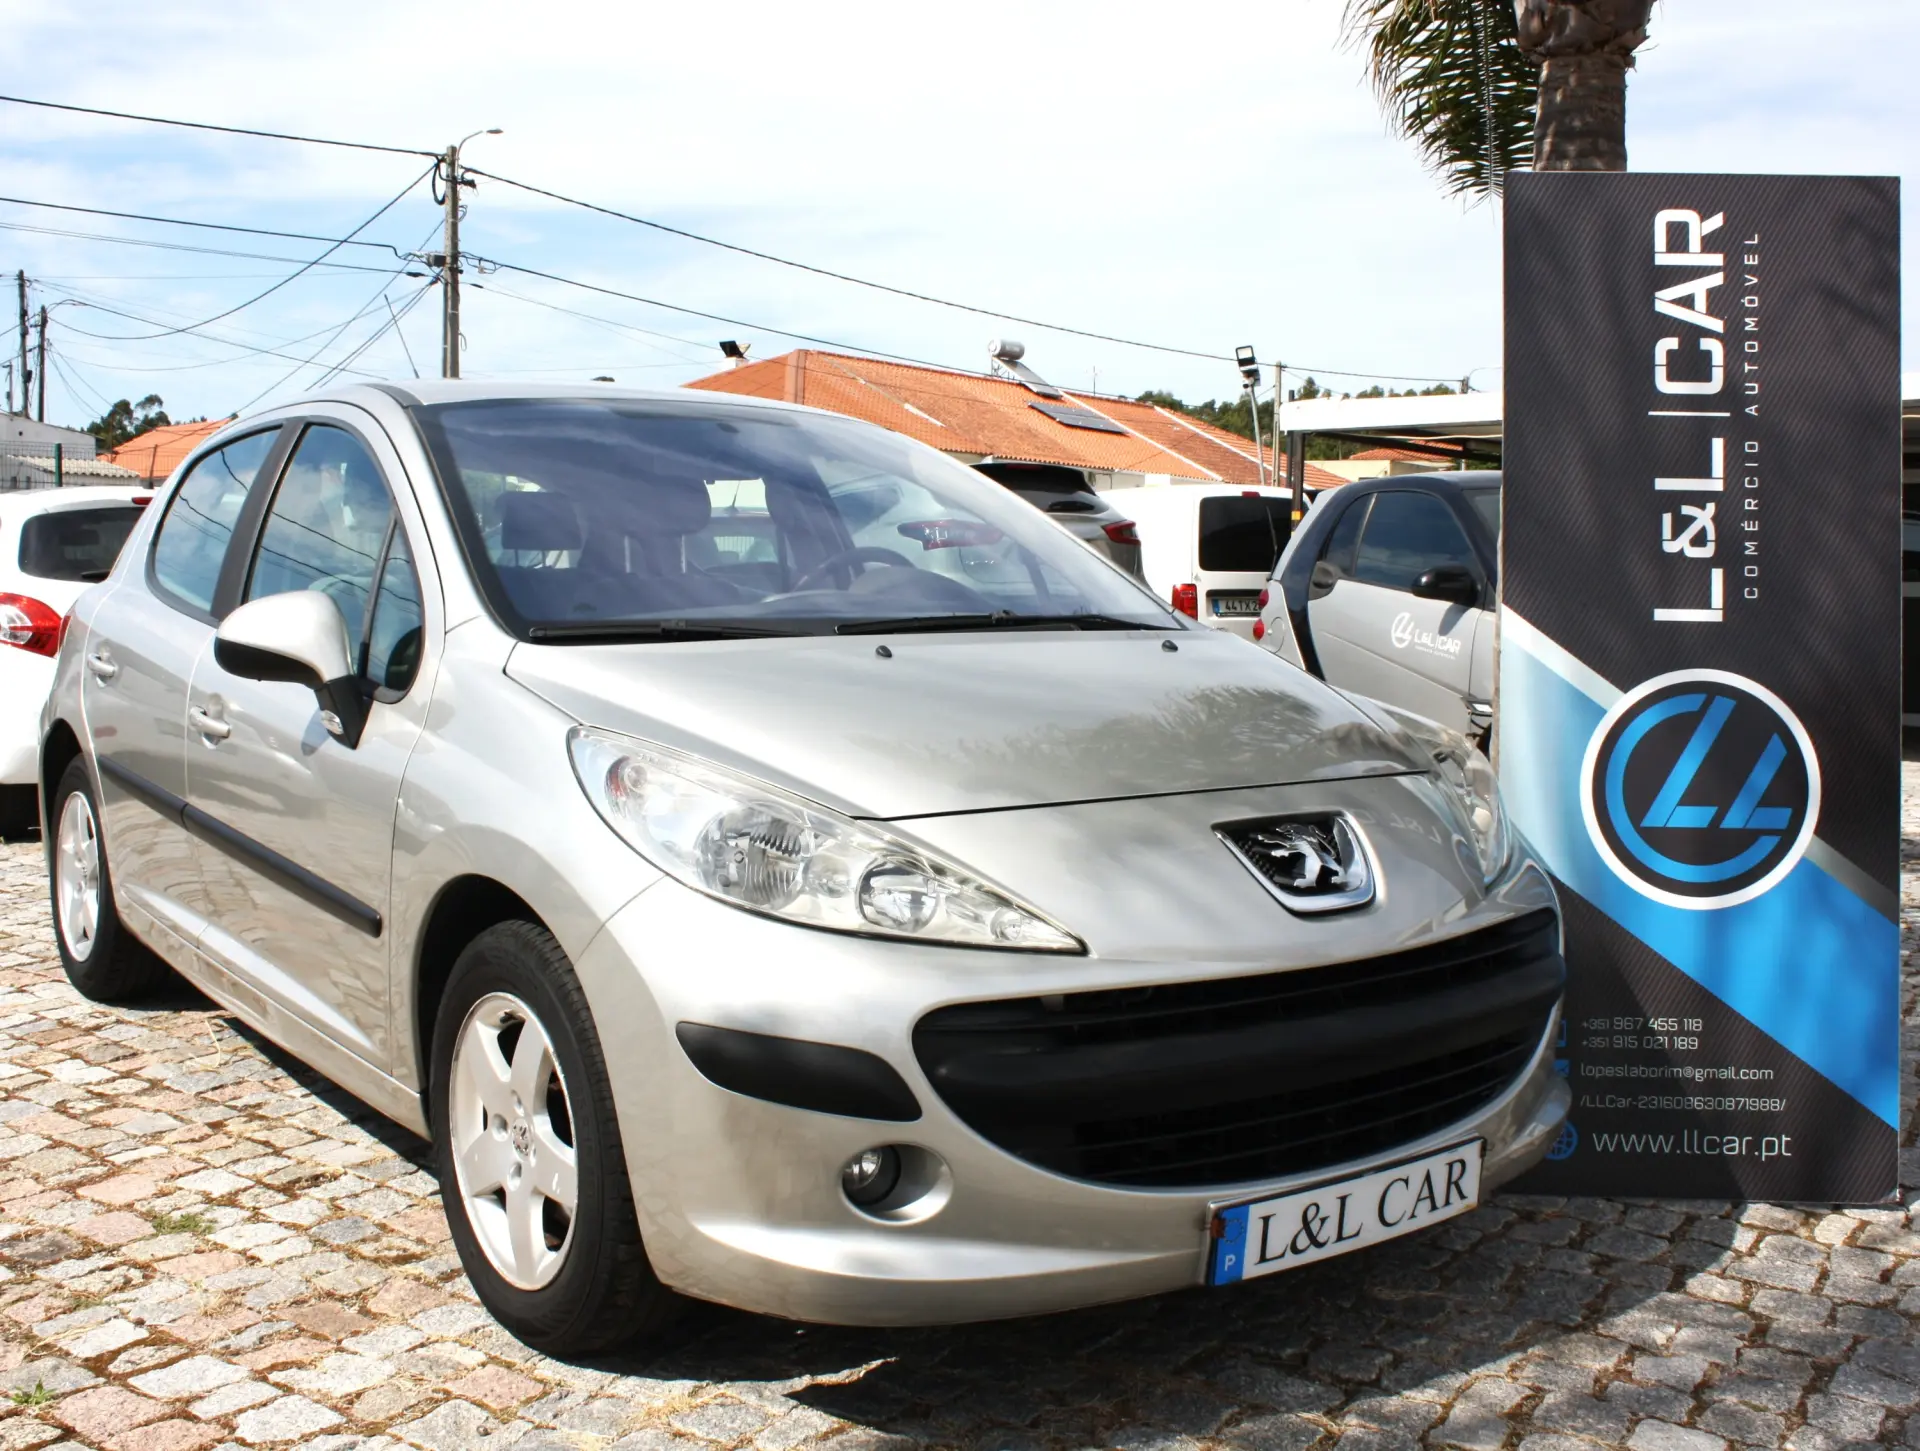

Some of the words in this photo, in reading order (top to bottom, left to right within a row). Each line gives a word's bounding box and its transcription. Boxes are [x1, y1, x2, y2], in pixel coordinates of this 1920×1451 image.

[1654, 208, 1724, 395] CAR
[1741, 233, 1759, 416] AUTOMÓVEL
[1741, 440, 1759, 598] COMÉRCIO
[1582, 1018, 1609, 1030] +351
[1613, 1017, 1643, 1030] 967
[1648, 1018, 1678, 1031] 455
[1683, 1018, 1703, 1032] 118
[1582, 1036, 1609, 1048] +351
[1613, 1035, 1638, 1048] 915
[1643, 1036, 1668, 1049] 021
[1673, 1036, 1698, 1050] 189
[1580, 1063, 1774, 1082] lopeslaborim@gmail.com
[1592, 1129, 1792, 1162] www.llcar.pt
[1254, 1193, 1363, 1265] L&L
[1377, 1158, 1468, 1228] CAR
[1224, 1254, 1235, 1272] P
